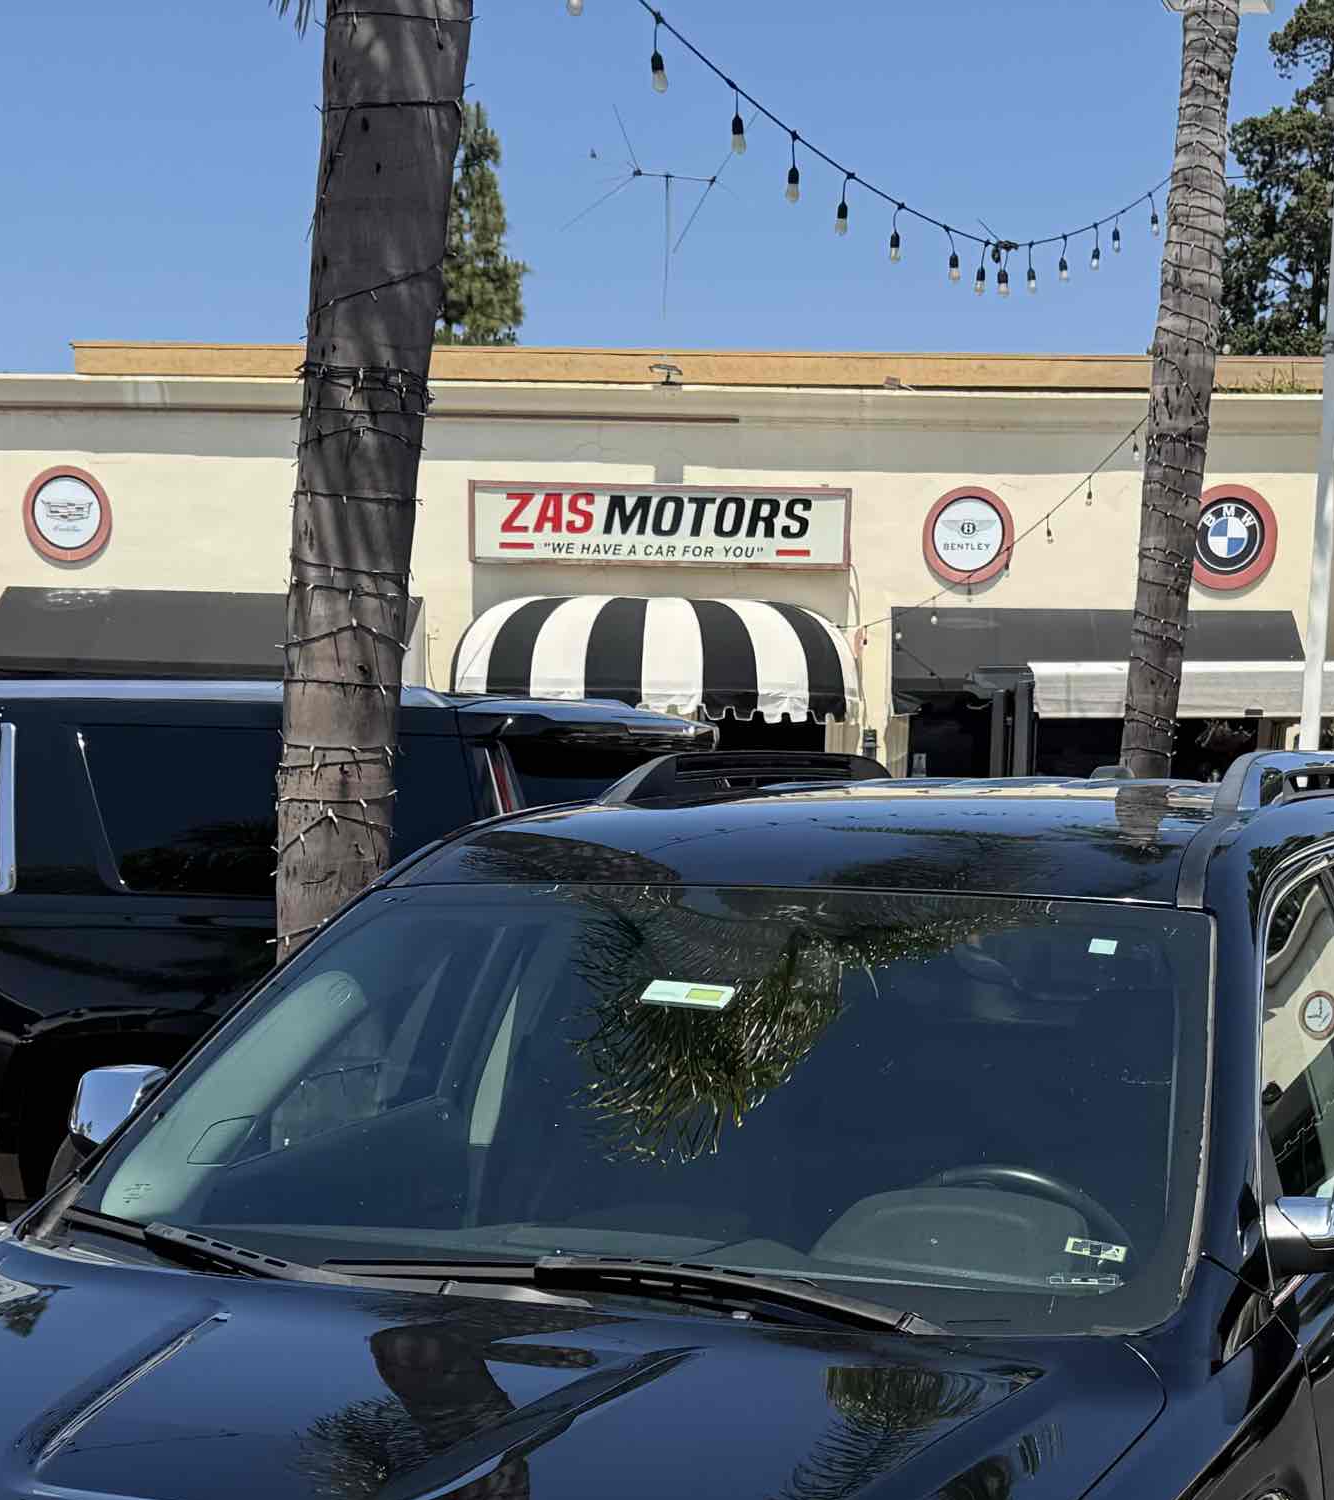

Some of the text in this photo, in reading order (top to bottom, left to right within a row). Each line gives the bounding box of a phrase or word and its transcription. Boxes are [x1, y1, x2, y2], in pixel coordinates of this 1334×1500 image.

[500, 492, 813, 540] ZAS MOTORS
[1202, 505, 1257, 528] BMW
[580, 543, 625, 556] HAVE
[627, 543, 640, 556] A
[643, 544, 676, 557] CAR
[682, 545, 715, 558] FOR
[942, 543, 991, 551] BENTLEY
